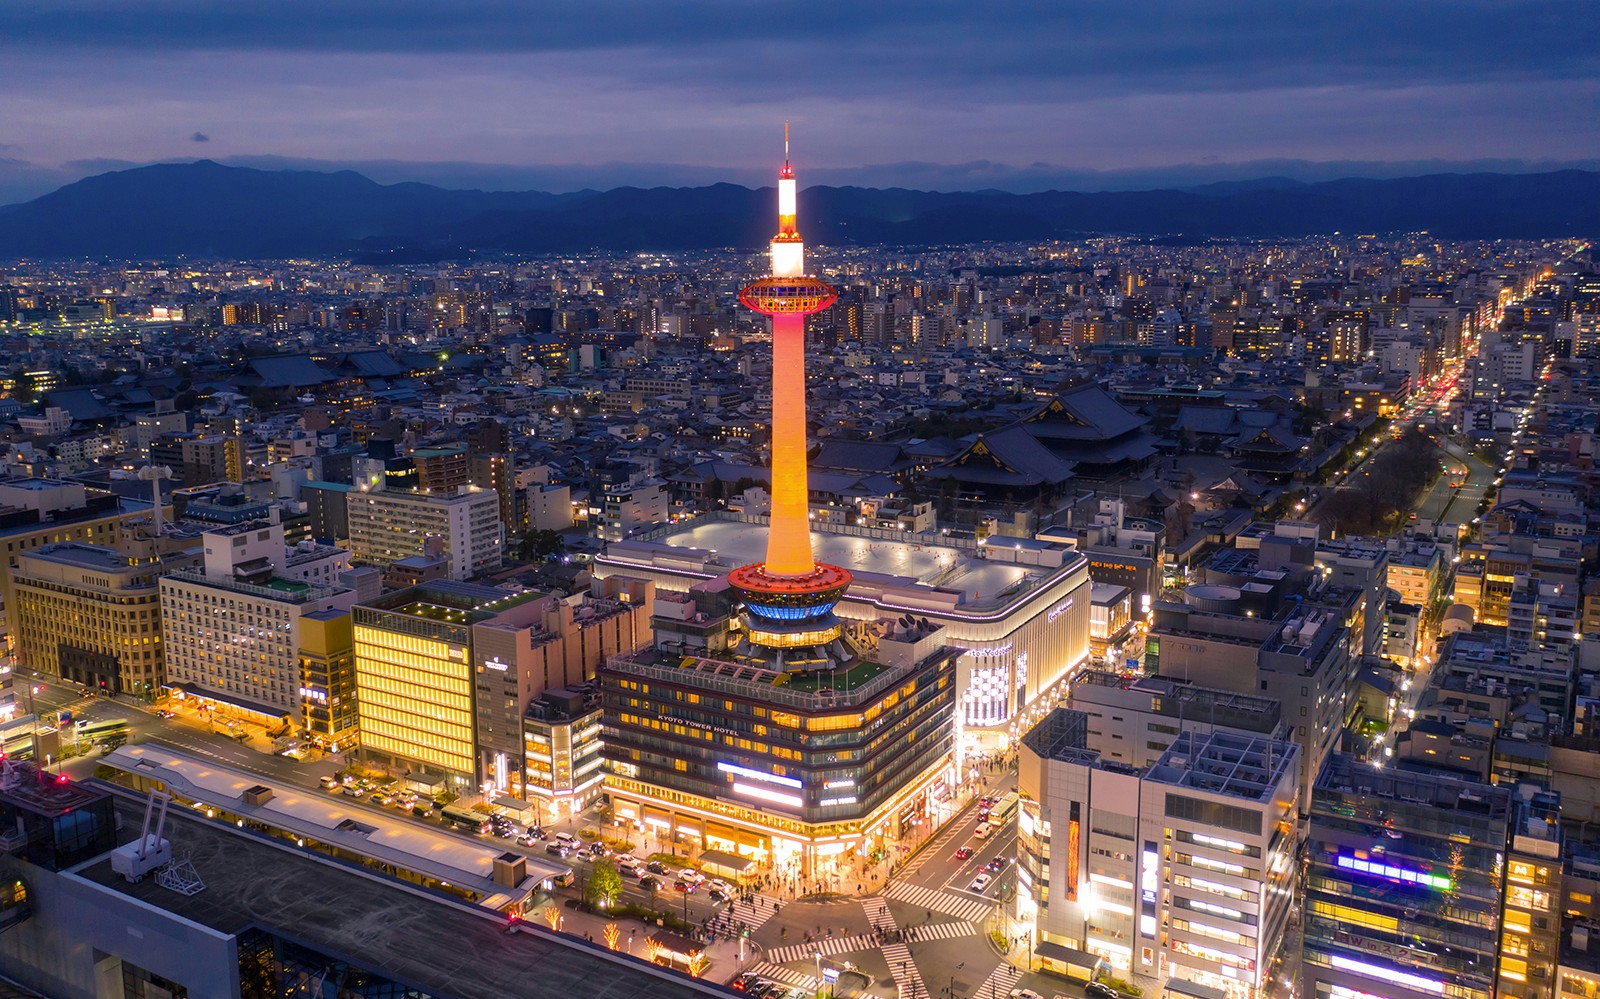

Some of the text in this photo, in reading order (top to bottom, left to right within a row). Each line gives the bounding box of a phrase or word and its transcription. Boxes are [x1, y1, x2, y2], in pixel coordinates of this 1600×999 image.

[658, 714, 739, 737] KYOTO TOWER HOTEL
